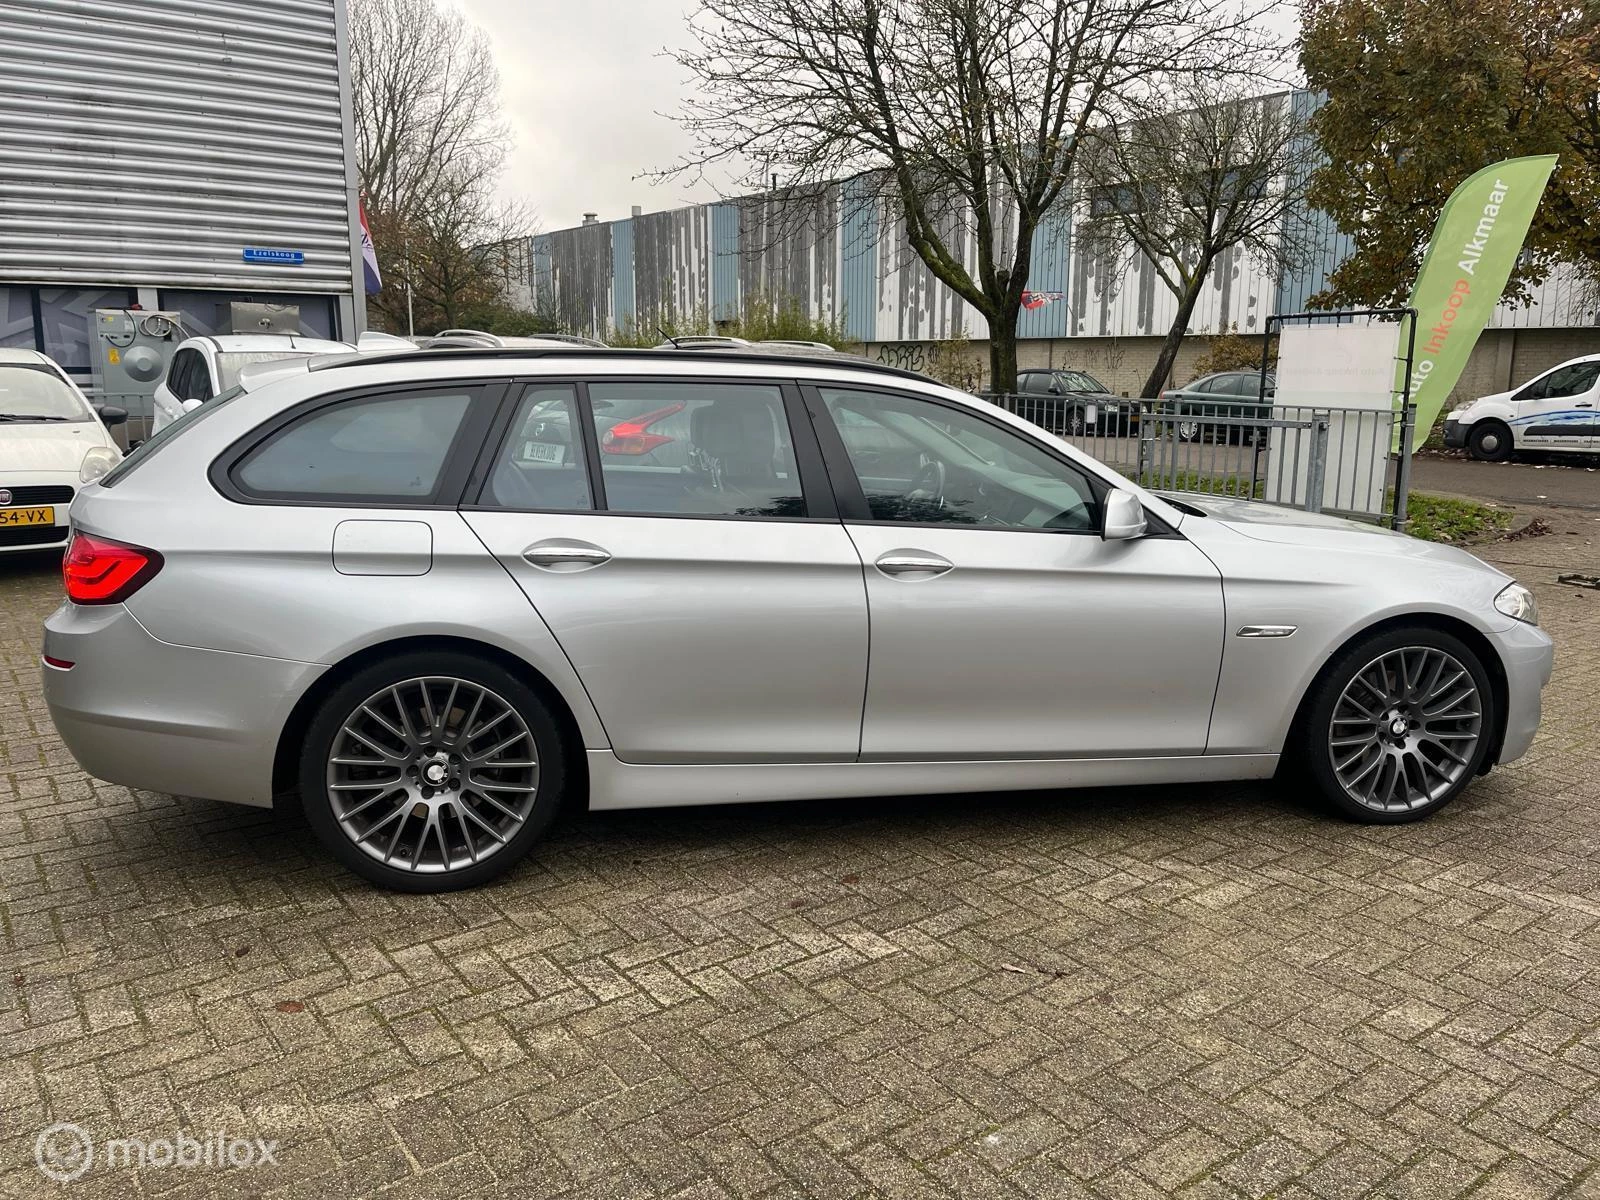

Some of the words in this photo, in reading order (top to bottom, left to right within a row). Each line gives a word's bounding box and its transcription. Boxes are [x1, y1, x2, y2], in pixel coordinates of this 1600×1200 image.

[253, 250, 295, 259] Ezelskoog
[1422, 278, 1471, 354] Inkoop
[1457, 178, 1509, 276] Alkmaar
